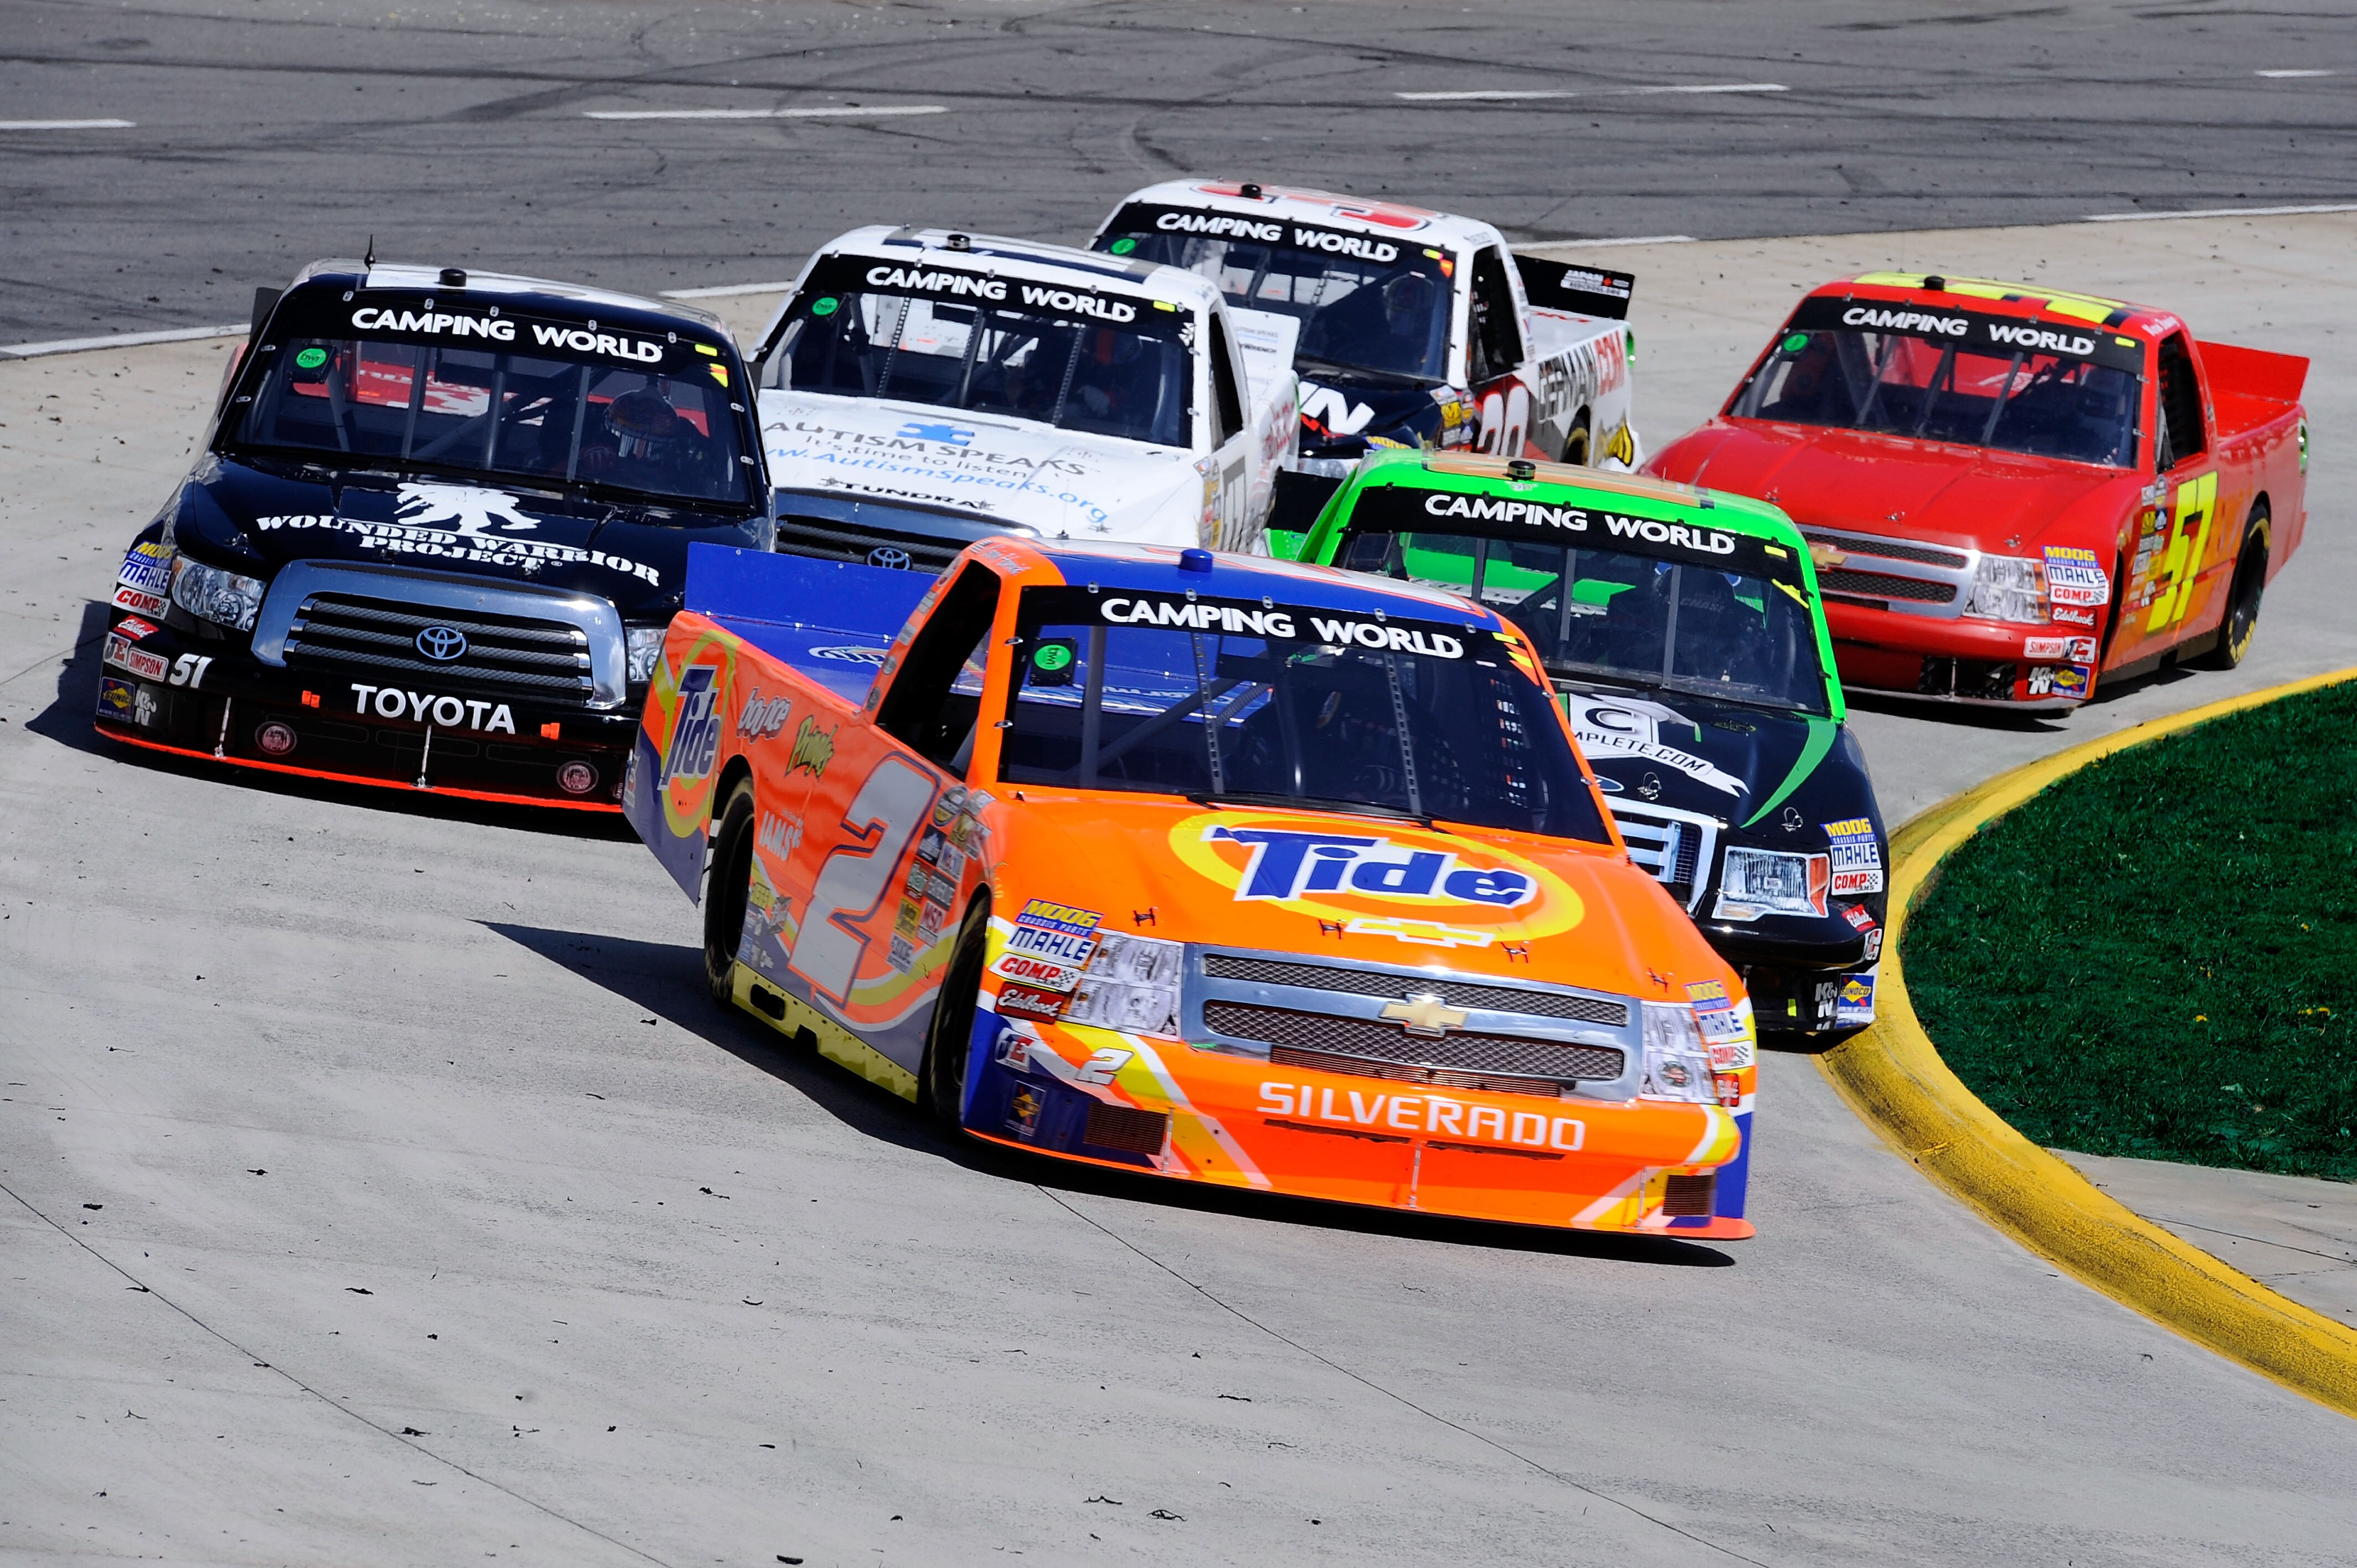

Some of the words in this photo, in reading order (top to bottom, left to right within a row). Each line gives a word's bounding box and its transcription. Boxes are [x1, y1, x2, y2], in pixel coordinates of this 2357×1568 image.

[1156, 213, 1282, 242] CAMPING
[1294, 227, 1398, 262] WORLD
[866, 266, 1007, 301] CAMPING
[1022, 285, 1136, 323] WORLD
[352, 308, 515, 342] CAMPING
[532, 324, 663, 363] WORLD
[1842, 307, 1968, 337] CAMPING
[1989, 323, 2096, 355] WORLD
[764, 421, 925, 452] AUTISM
[936, 445, 1087, 476] SPEAKS
[853, 446, 912, 461] time
[922, 455, 948, 466] to
[956, 461, 1027, 478] listen
[838, 481, 978, 509] TUNDRA
[1425, 493, 1588, 532] CAMPING
[1604, 515, 1737, 556] WORLD
[136, 541, 173, 559] MOOG
[256, 514, 457, 545] WOUNDED
[471, 538, 660, 587] WARRIOR
[2045, 545, 2096, 562] MOOG
[119, 561, 169, 590] MAHLE
[2049, 566, 2105, 585] MAHLE
[116, 590, 160, 610] COMP
[2054, 587, 2092, 601] COMP
[1100, 597, 1295, 638] CAMPING
[1310, 616, 1465, 659] WORLD
[129, 652, 163, 676] SIMPSON
[169, 653, 214, 689] 51
[351, 683, 516, 735] TOYOTA
[657, 665, 721, 791] Tide
[1825, 818, 1872, 837] MOOG
[1205, 825, 1536, 907] Tide
[1832, 844, 1878, 865] MAHLE
[787, 751, 941, 1010] 2
[1835, 873, 1867, 889] COMP
[1023, 900, 1103, 927] MOOG
[1008, 927, 1093, 961] MAHLE
[1001, 957, 1062, 981] COMP
[1840, 987, 1870, 996] SUNOCO
[1074, 1047, 1134, 1086] 2
[1256, 1081, 1587, 1152] SILVERADO
